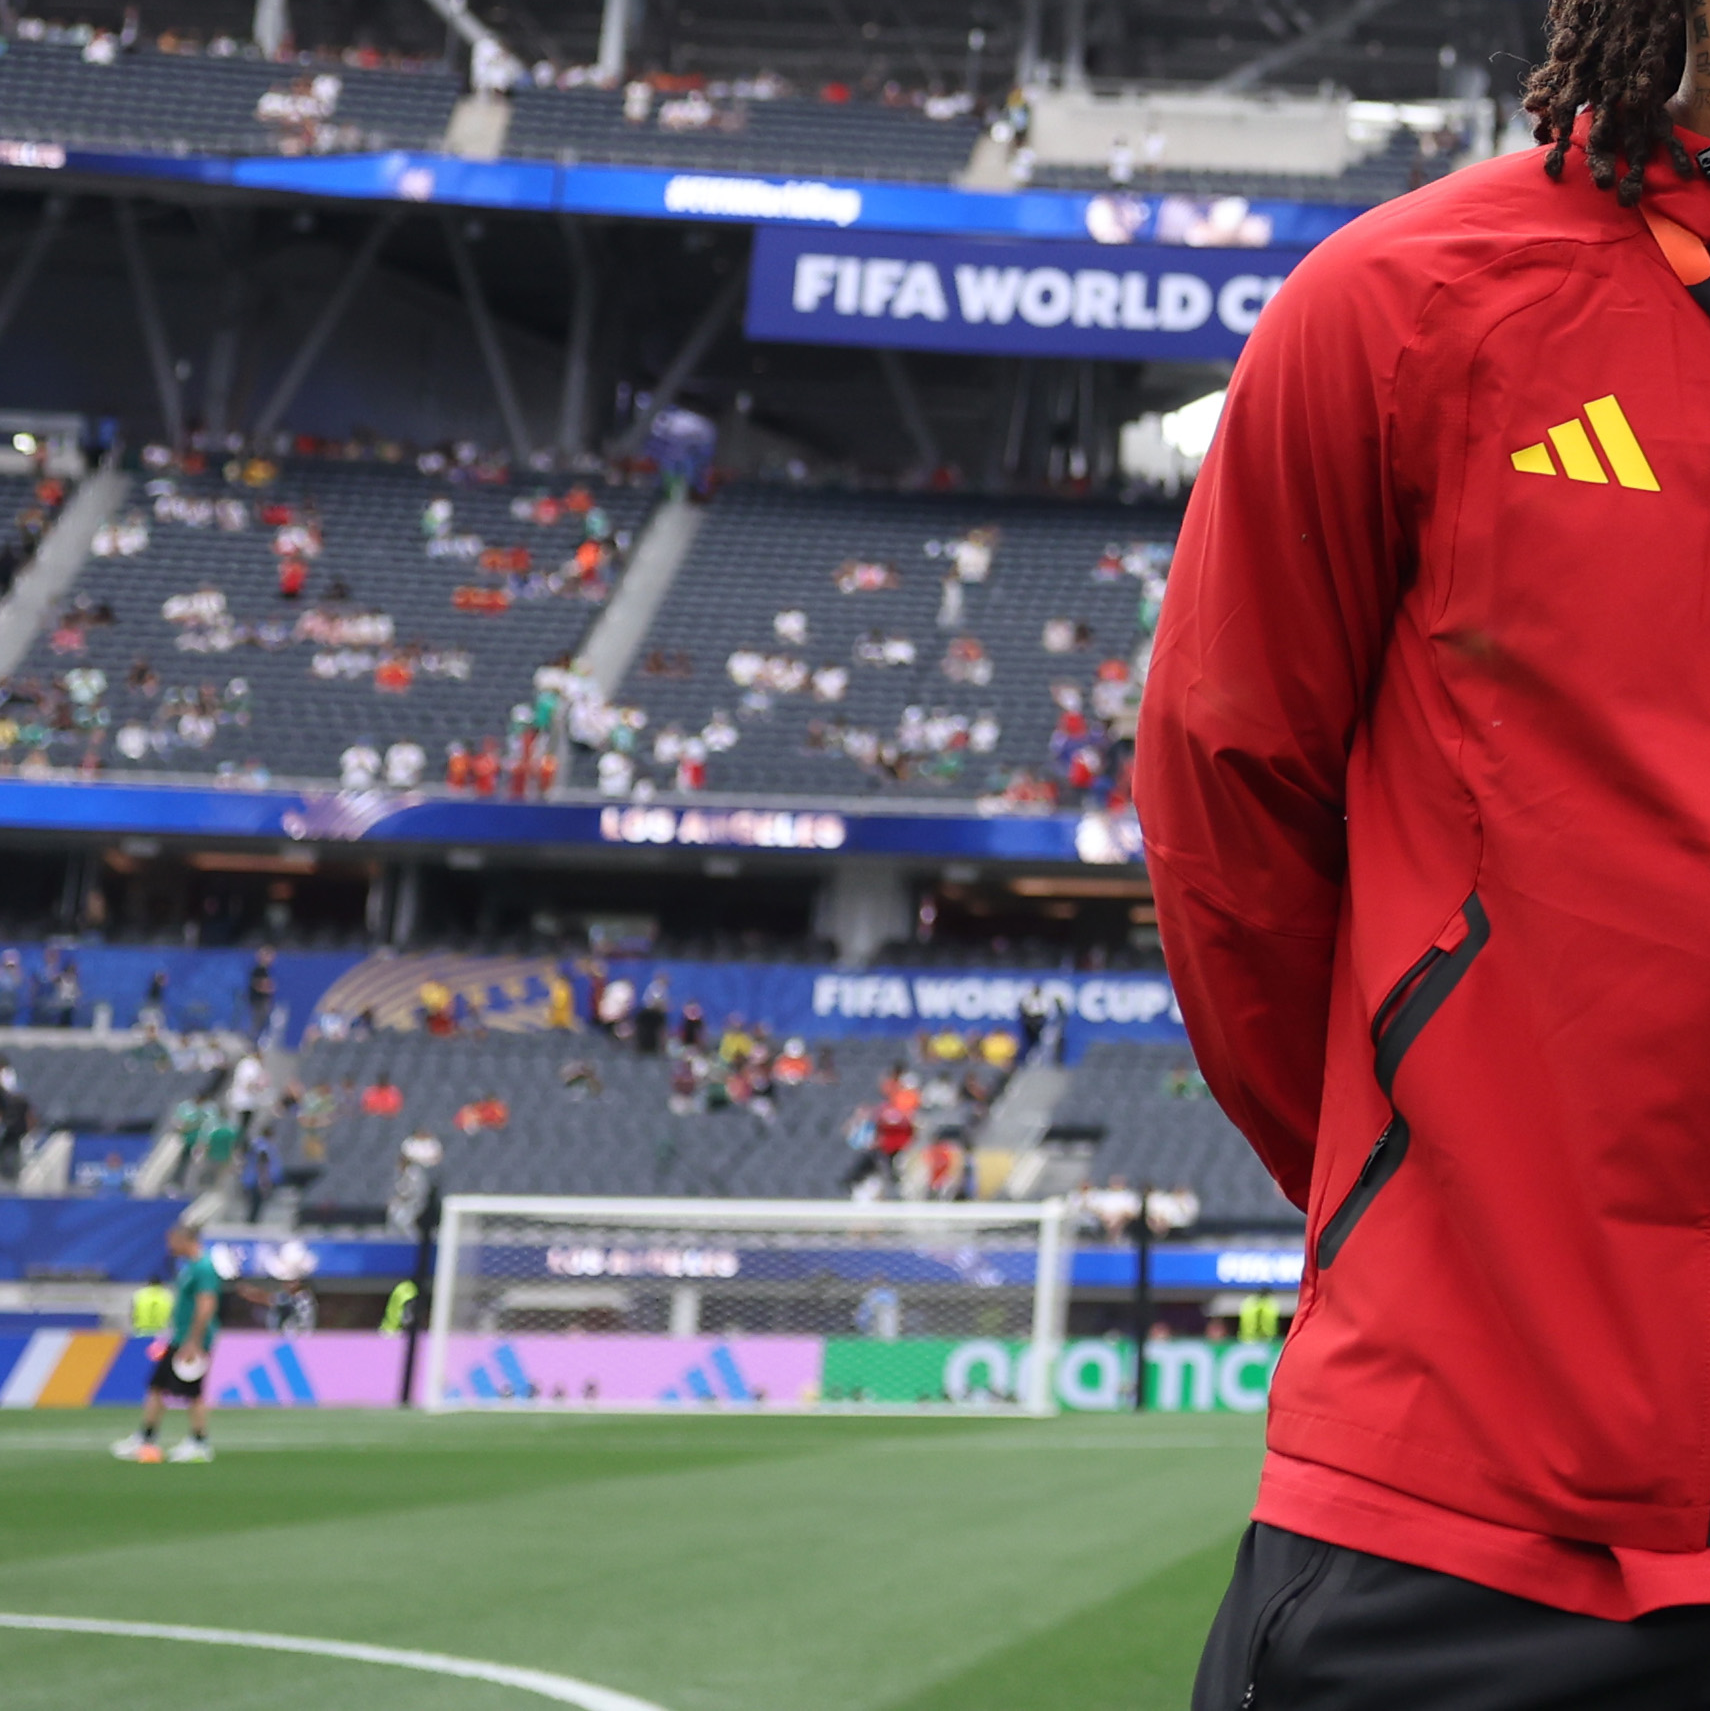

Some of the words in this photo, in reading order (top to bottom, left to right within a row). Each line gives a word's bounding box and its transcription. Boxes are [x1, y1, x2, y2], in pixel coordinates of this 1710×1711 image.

[792, 252, 950, 323] FIFA
[954, 262, 1213, 334] WORLD
[1217, 273, 1290, 335] C
[811, 975, 914, 1020] FIFA
[1076, 978, 1171, 1024] CUP
